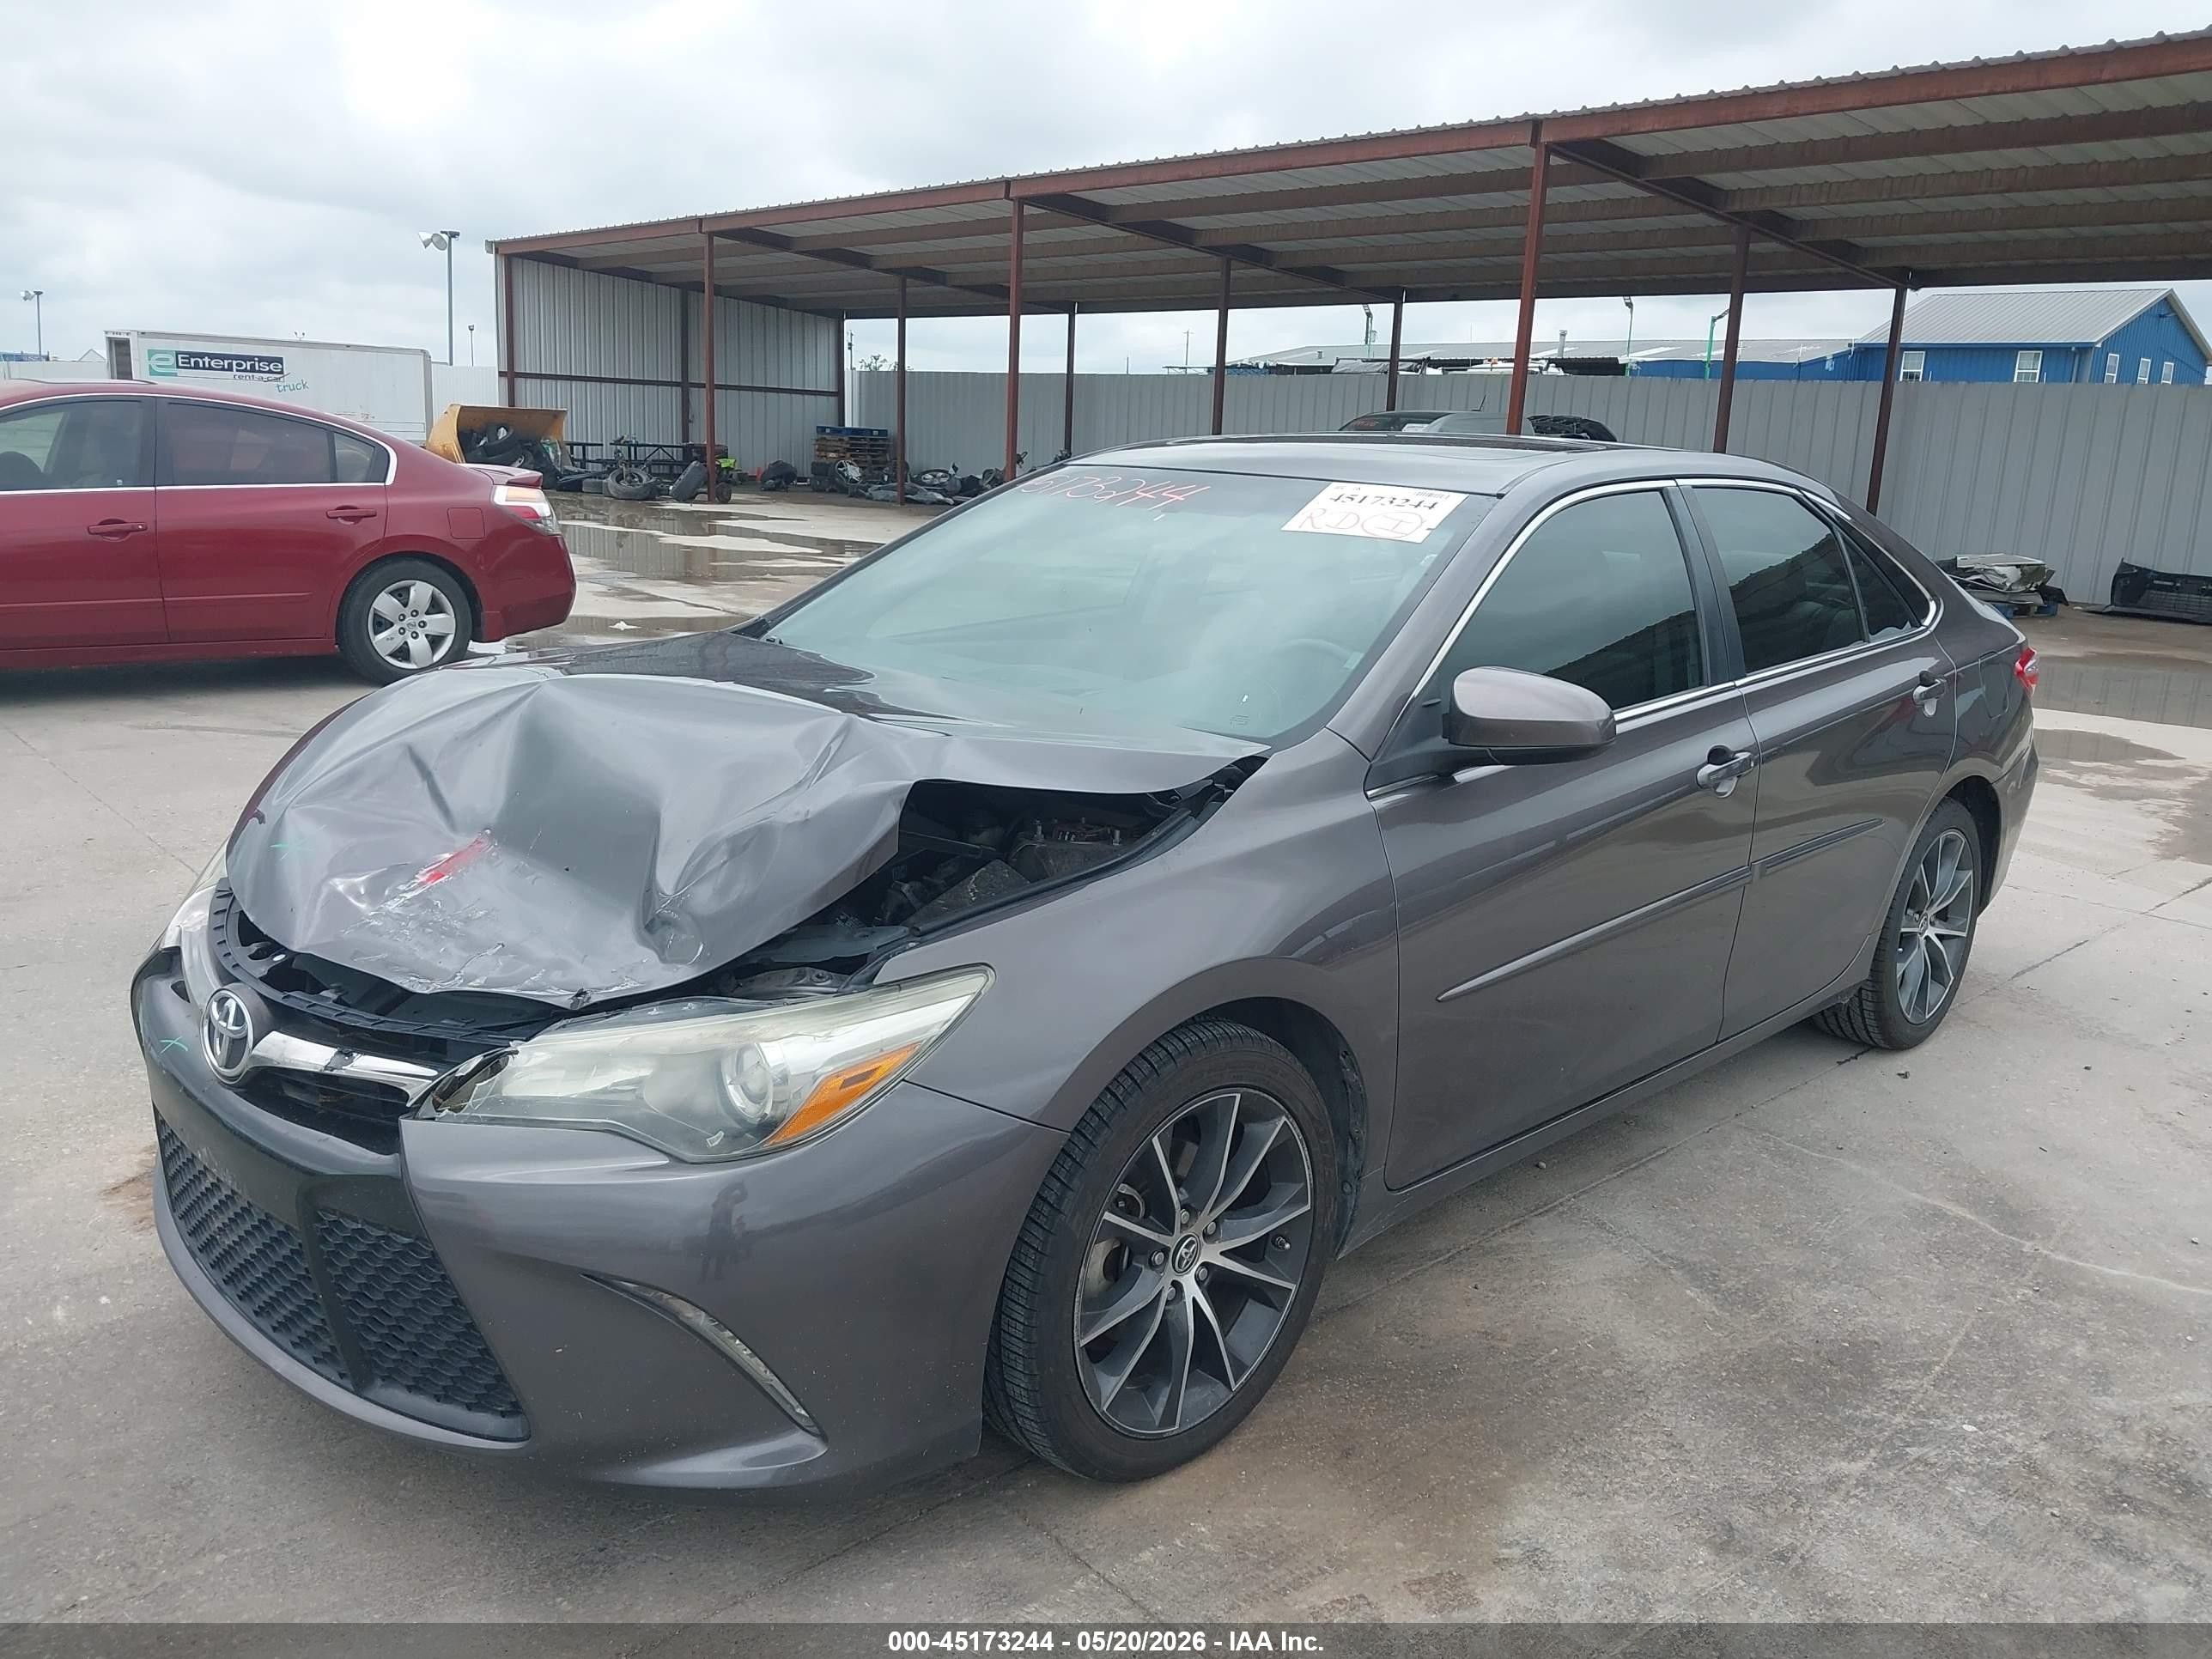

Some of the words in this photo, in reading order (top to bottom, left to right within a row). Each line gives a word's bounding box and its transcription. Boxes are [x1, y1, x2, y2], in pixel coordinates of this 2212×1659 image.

[178, 354, 283, 373] Enterprise
[233, 373, 283, 382] rent-a-car
[276, 379, 309, 393] truck
[1329, 493, 1439, 510] 45173244
